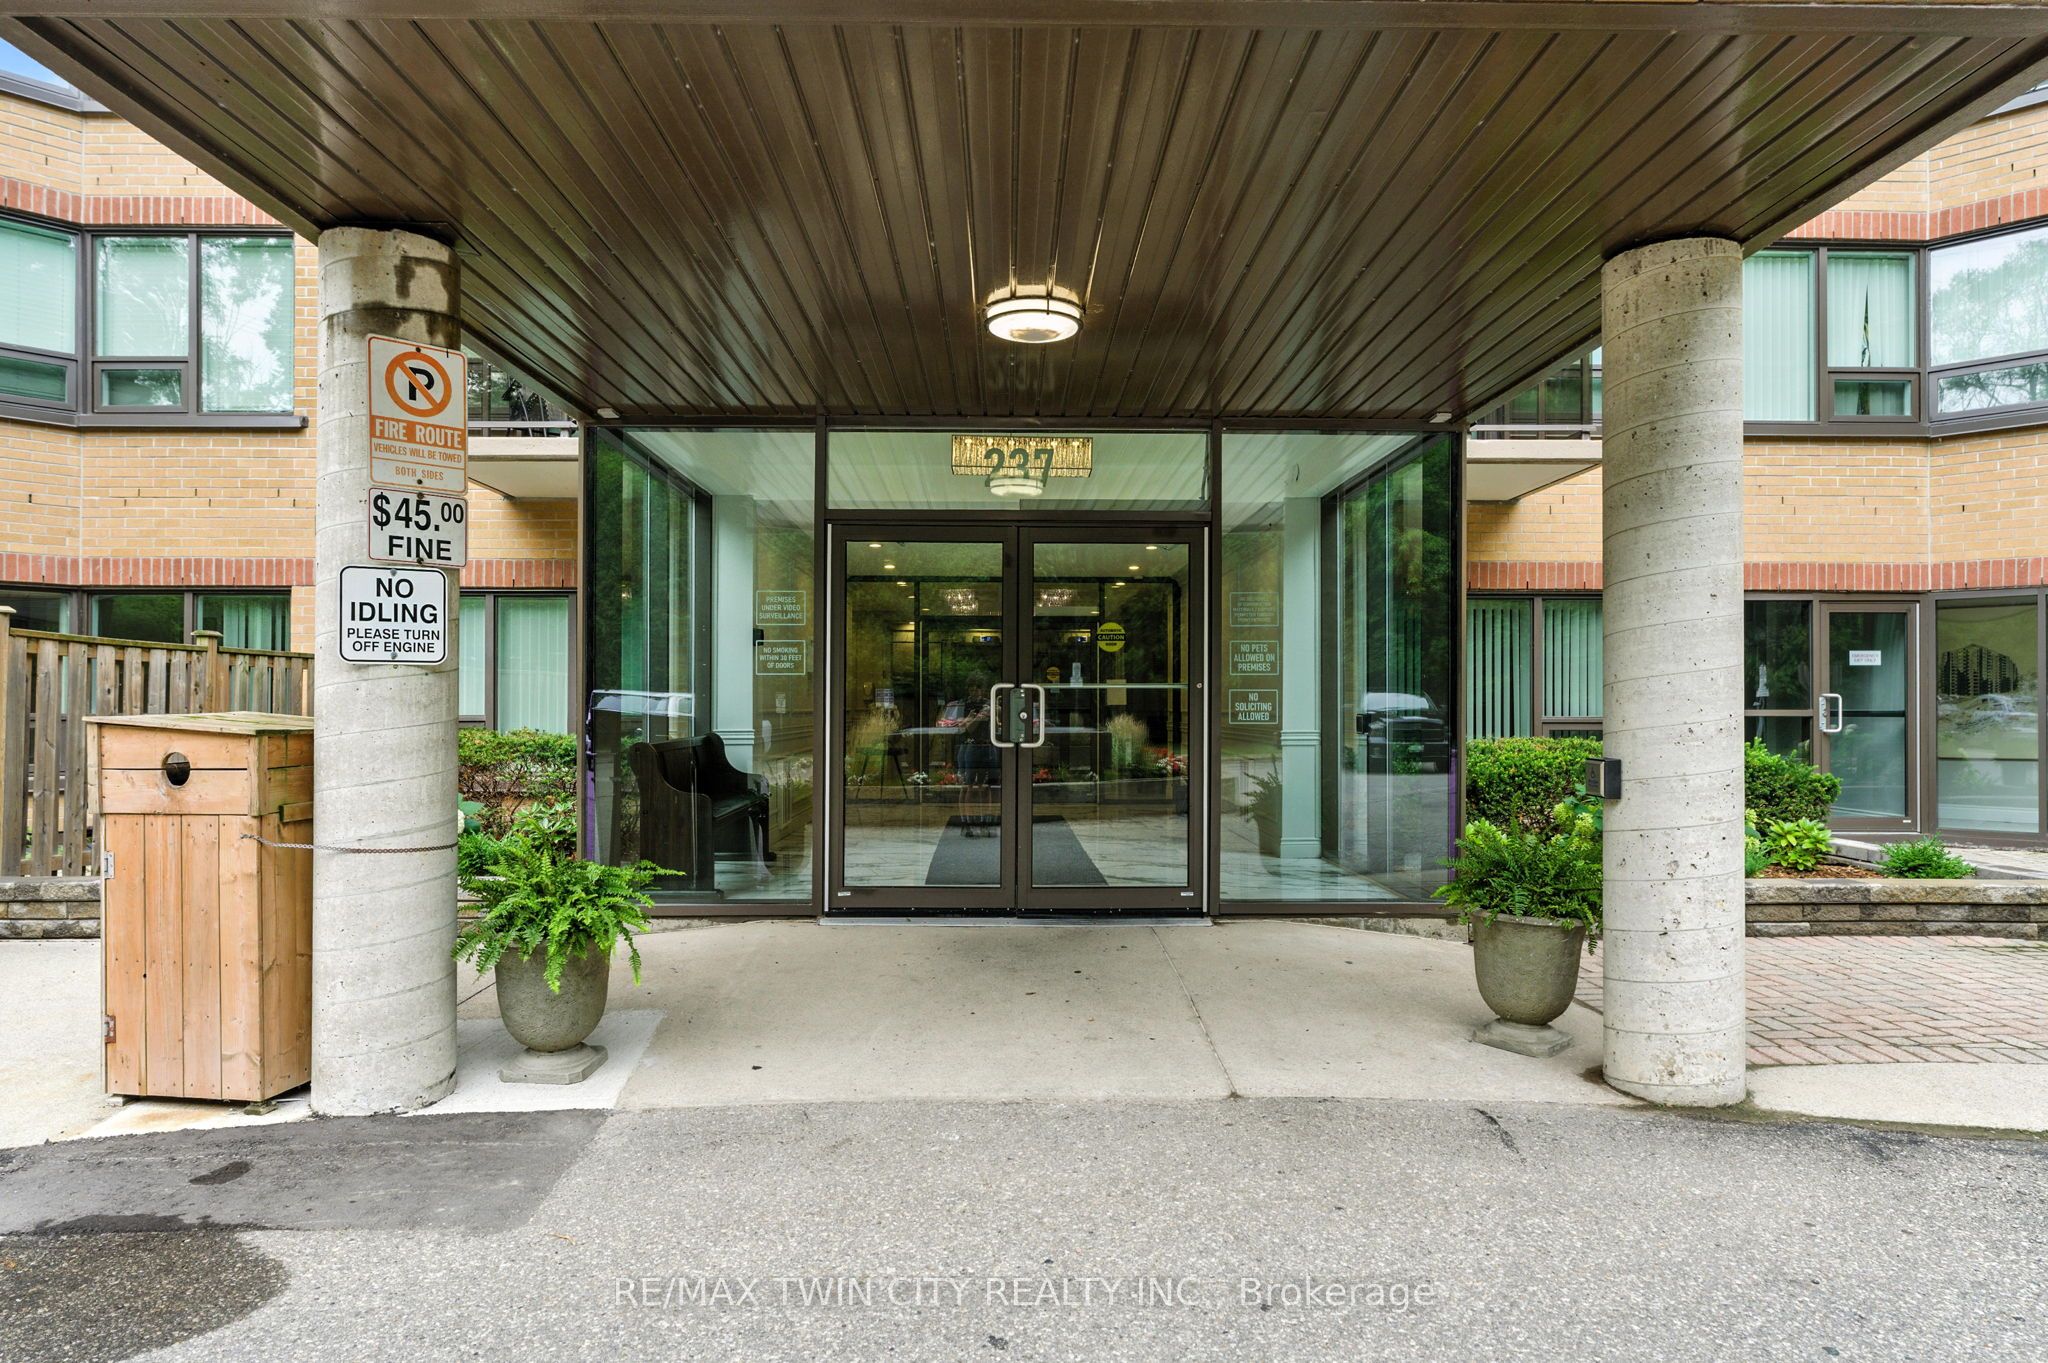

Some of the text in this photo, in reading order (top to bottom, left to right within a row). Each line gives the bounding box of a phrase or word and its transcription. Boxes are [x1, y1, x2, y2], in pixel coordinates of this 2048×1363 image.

[375, 419, 462, 448] FIRE ROUTE
[373, 442, 462, 464] VEHICLES WILL BE TOWED
[984, 447, 1055, 487] 237
[395, 467, 444, 481] BOTH SIDES
[388, 535, 452, 561] FINE
[376, 577, 414, 599] NO
[350, 601, 438, 624] IDLING
[347, 628, 440, 641] PLEASE TURN
[352, 641, 435, 653] OFF ENGINE
[1240, 644, 1268, 652] NO PETS
[1233, 653, 1276, 661] ALLOWED ON
[1237, 663, 1271, 672] PREMISES
[1248, 693, 1259, 701] NO
[1235, 702, 1272, 711] SOLICITING
[1237, 712, 1269, 720] ALLOWED
